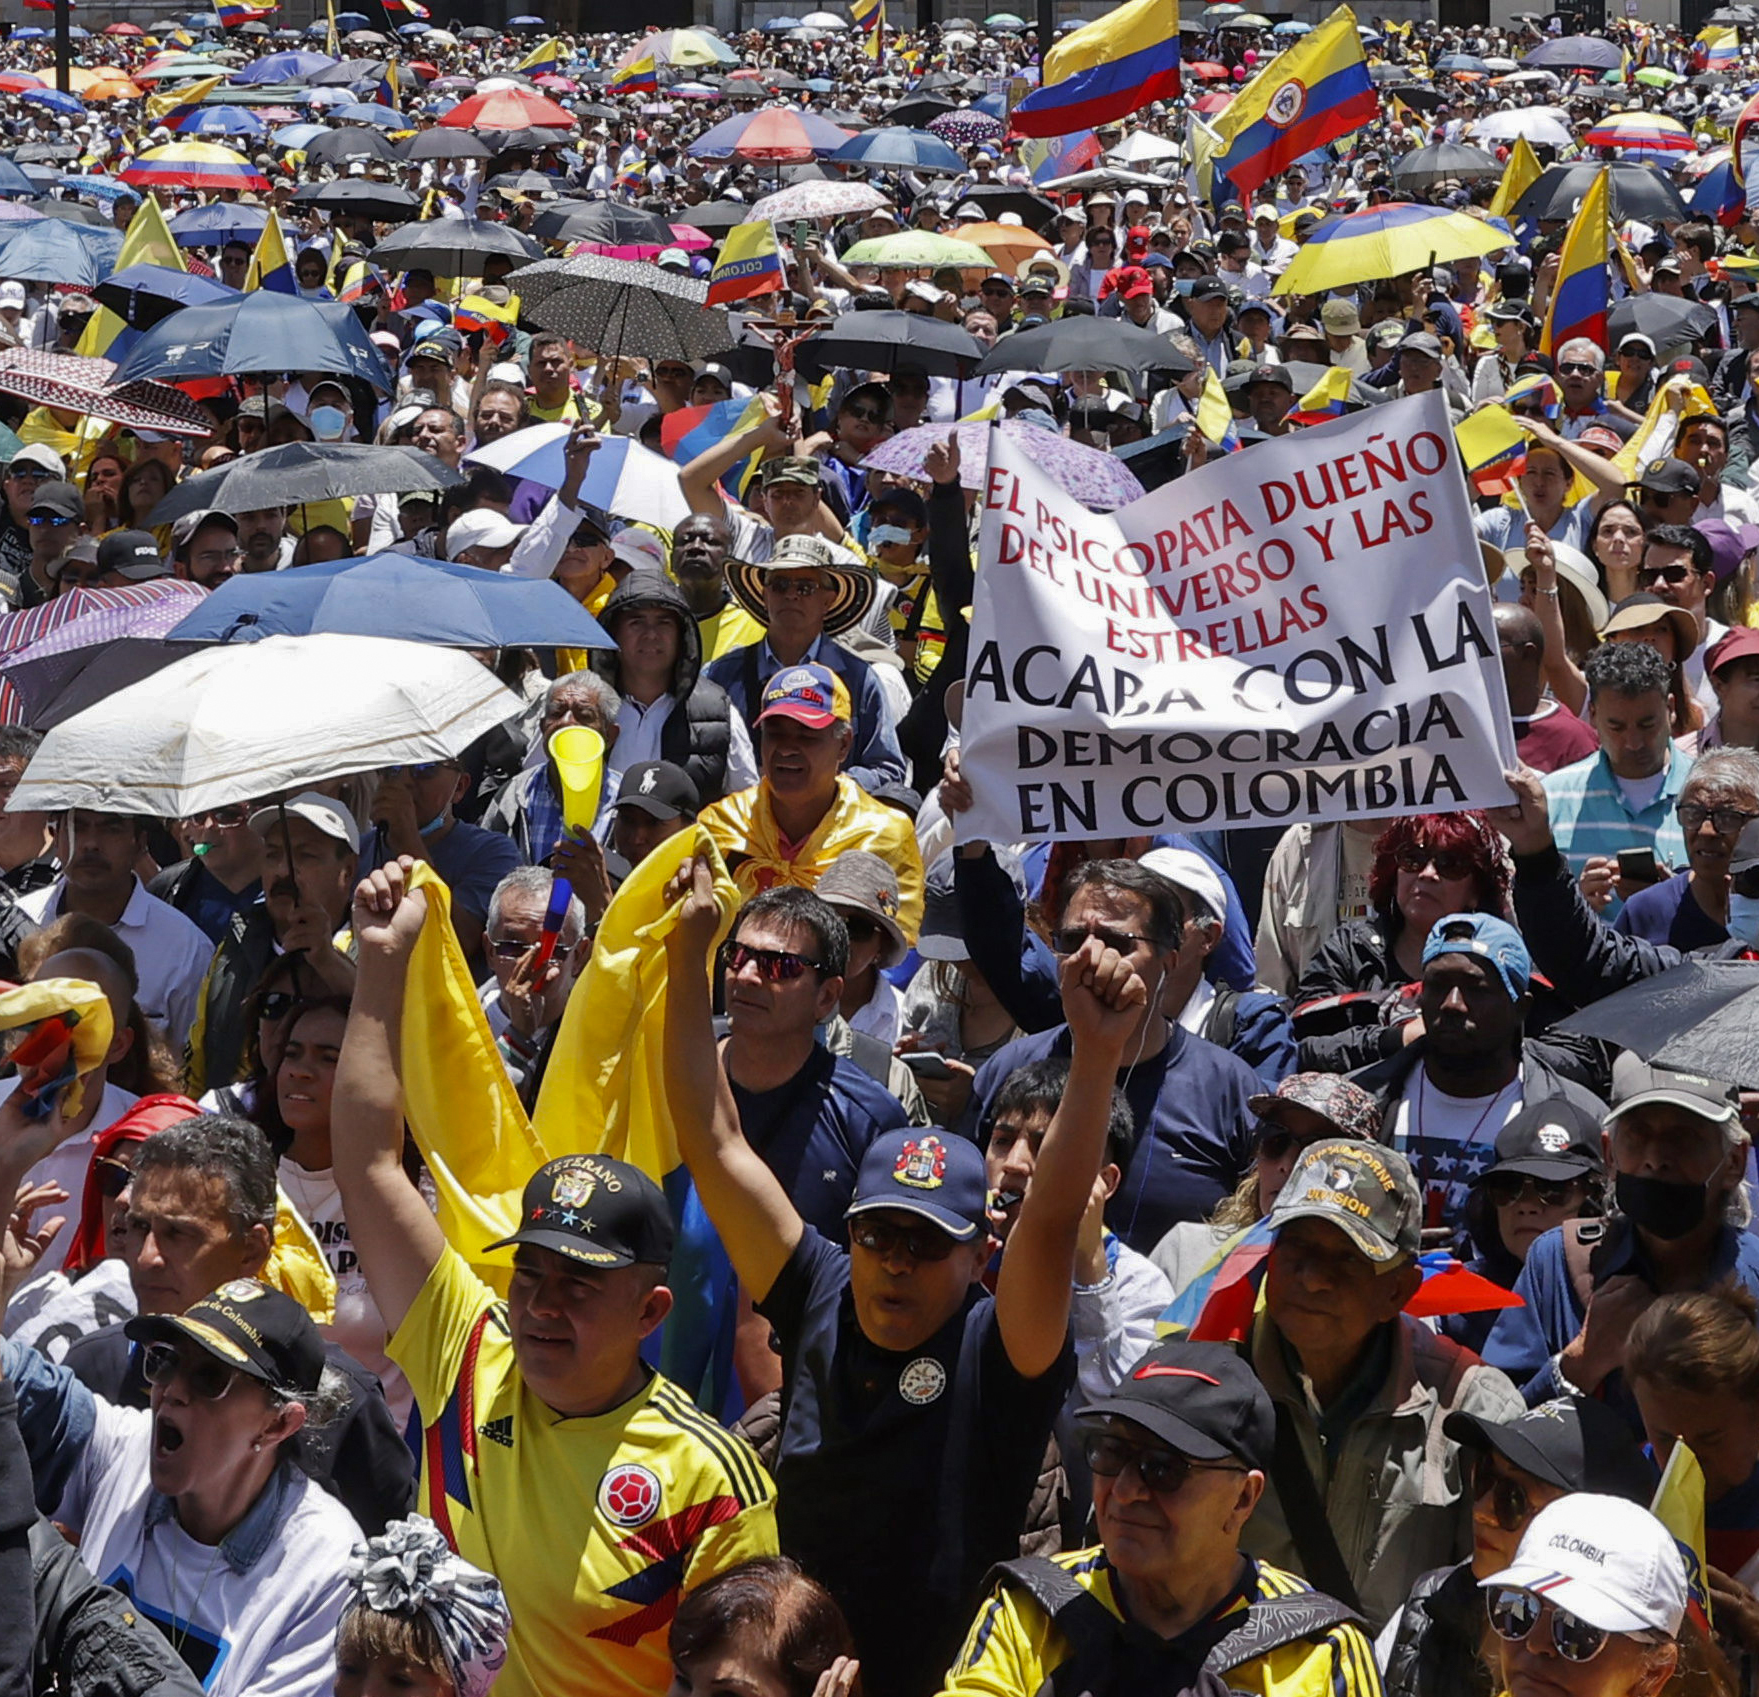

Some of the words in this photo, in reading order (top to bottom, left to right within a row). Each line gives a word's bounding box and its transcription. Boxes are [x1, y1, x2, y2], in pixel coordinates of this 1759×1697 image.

[986, 466, 1026, 517] EL
[1036, 497, 1254, 578] PSICOPATA
[1258, 431, 1448, 526] DUEÑO
[997, 522, 1065, 588] DEL
[1077, 537, 1296, 620] UNIVERSO
[1303, 524, 1335, 564] Y
[1351, 490, 1435, 551] LAS
[1106, 583, 1328, 665] ESTRELLAS
[964, 639, 1195, 719] ACABA
[1232, 620, 1395, 712] CON
[1410, 600, 1495, 674] LA
[1016, 692, 1464, 769] DEMOCRACIA
[1017, 781, 1098, 836] EN
[1121, 753, 1468, 827] COLOMBIA
[544, 1157, 623, 1193] VETERANO
[1332, 1145, 1396, 1192] AIRBORNE
[1307, 1187, 1371, 1218] DIVISION
[209, 1300, 222, 1311] de
[222, 1306, 263, 1348] Colombia
[478, 1425, 514, 1448] adidas
[1549, 1533, 1606, 1568] COLOMBIA
